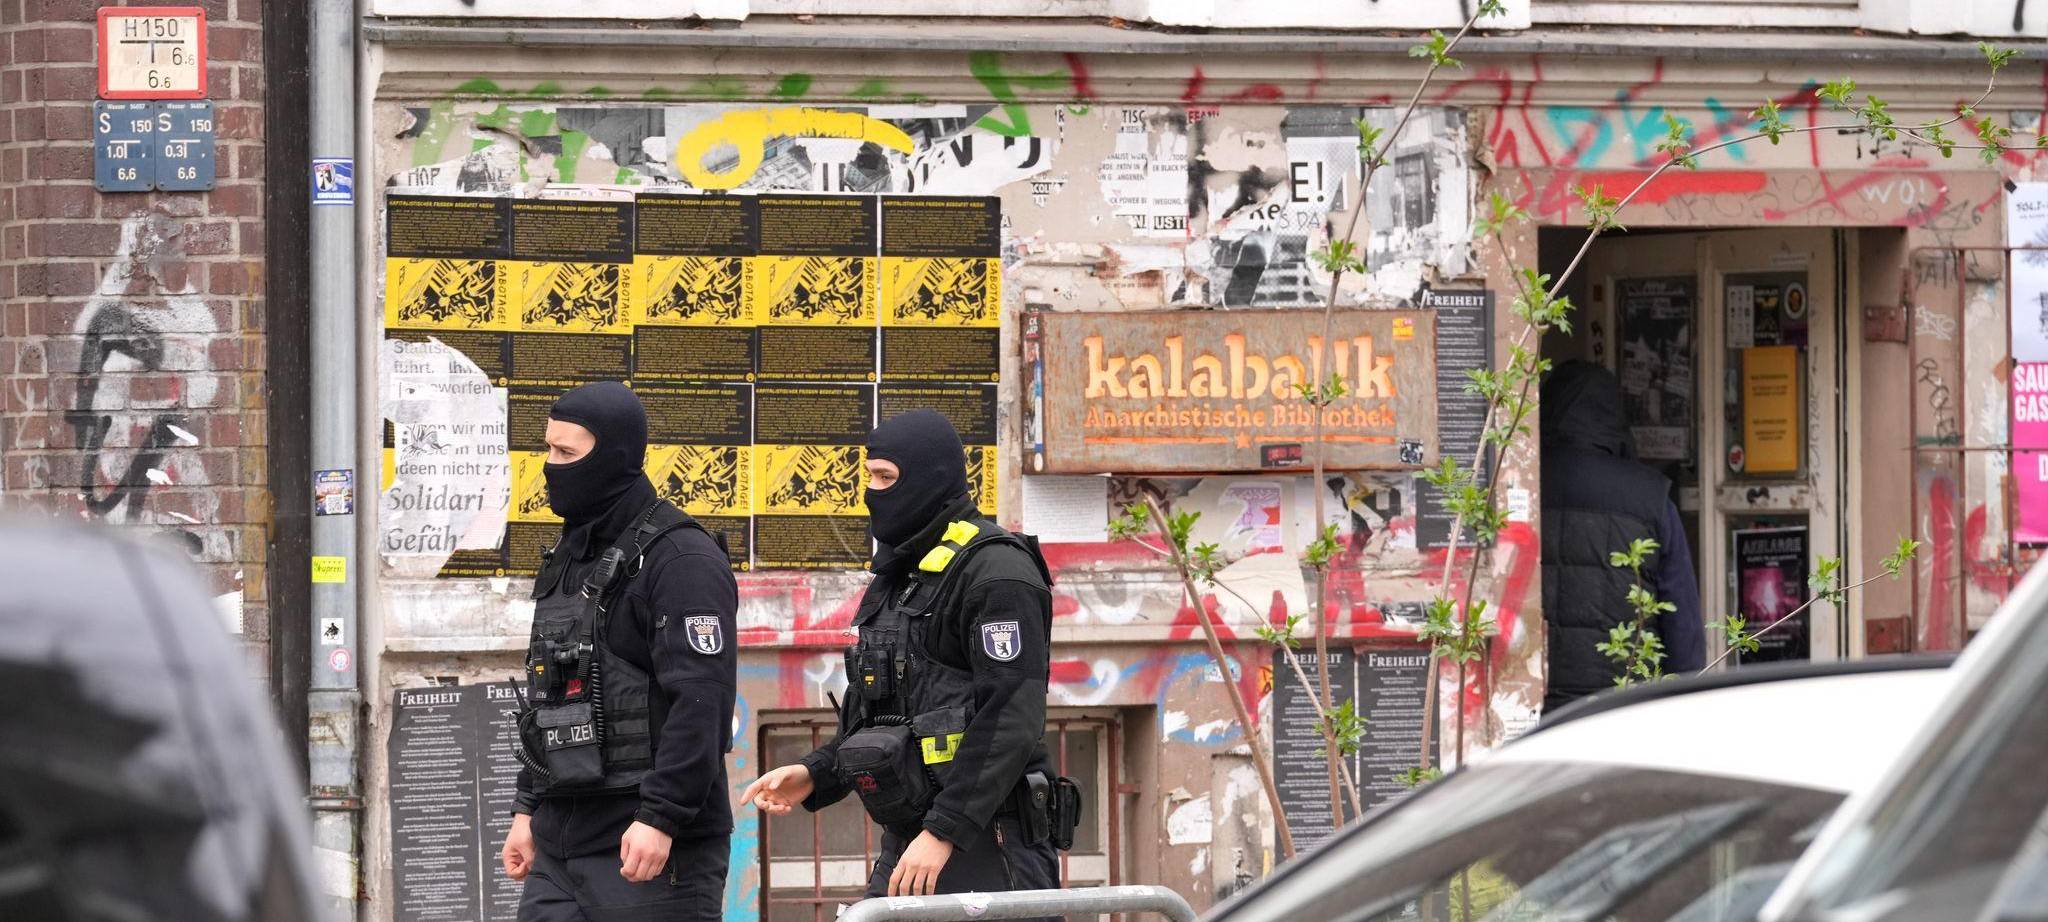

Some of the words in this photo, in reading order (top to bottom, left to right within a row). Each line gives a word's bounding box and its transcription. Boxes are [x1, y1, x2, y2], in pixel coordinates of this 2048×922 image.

[125, 18, 178, 38] H150
[99, 112, 111, 133] S
[130, 120, 152, 133] 150
[158, 112, 172, 132] S
[190, 120, 212, 132] 150
[1426, 291, 1485, 307] FREIHEIT
[1084, 404, 1266, 428] Anarchistische
[1272, 403, 1396, 428] Bibliothek
[452, 421, 476, 435] wir
[481, 421, 505, 435] mit
[443, 461, 481, 475] nicht
[389, 484, 485, 511] Solidari
[388, 523, 462, 553] Gefäh
[687, 617, 719, 627] POLIZEI
[985, 624, 1016, 634] POLIZEI
[1368, 653, 1428, 668] FREIHEIT
[400, 691, 462, 706] FREIHEIT
[486, 685, 528, 700] FREIH
[547, 724, 593, 746] POIZEI
